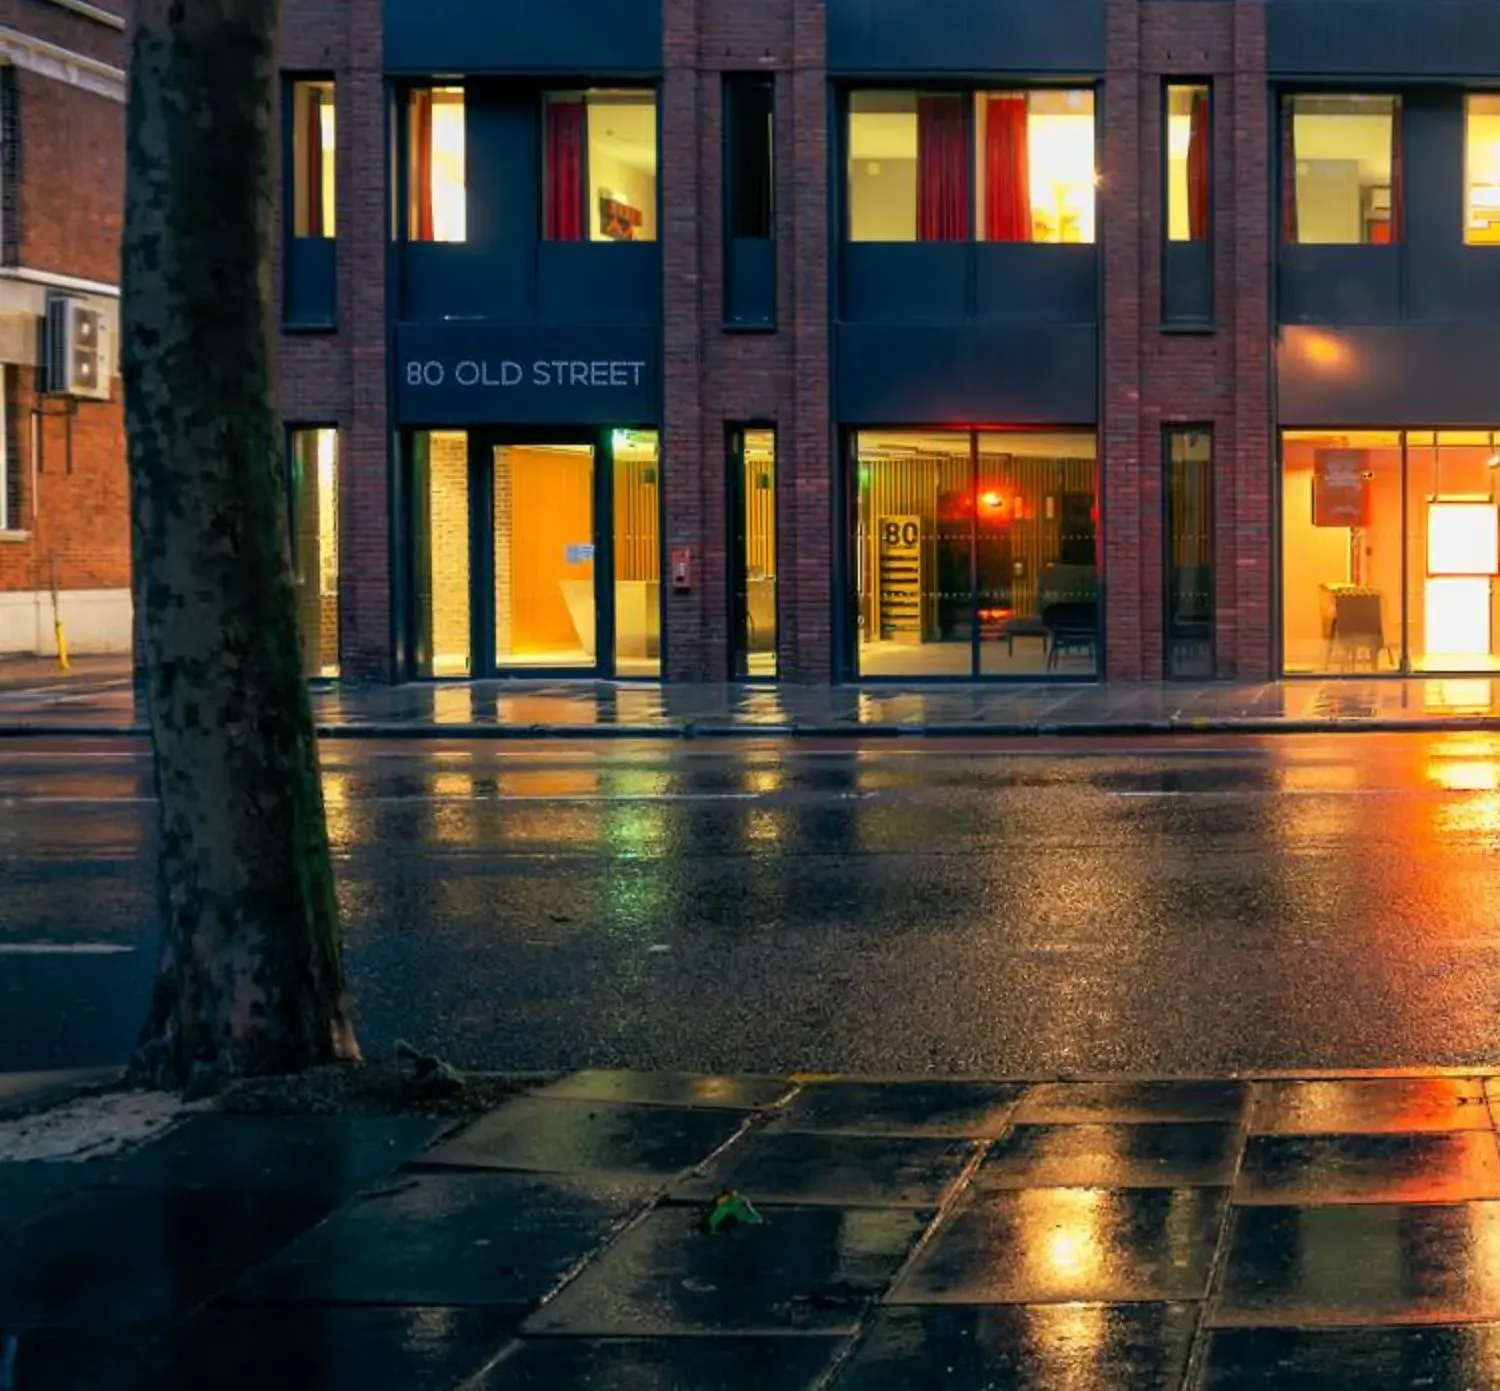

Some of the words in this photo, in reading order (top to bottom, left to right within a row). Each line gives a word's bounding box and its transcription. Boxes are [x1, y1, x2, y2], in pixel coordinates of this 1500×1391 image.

[406, 360, 445, 386] 80
[455, 360, 523, 386] OLD
[532, 360, 646, 386] STREET
[885, 521, 919, 546] 80
